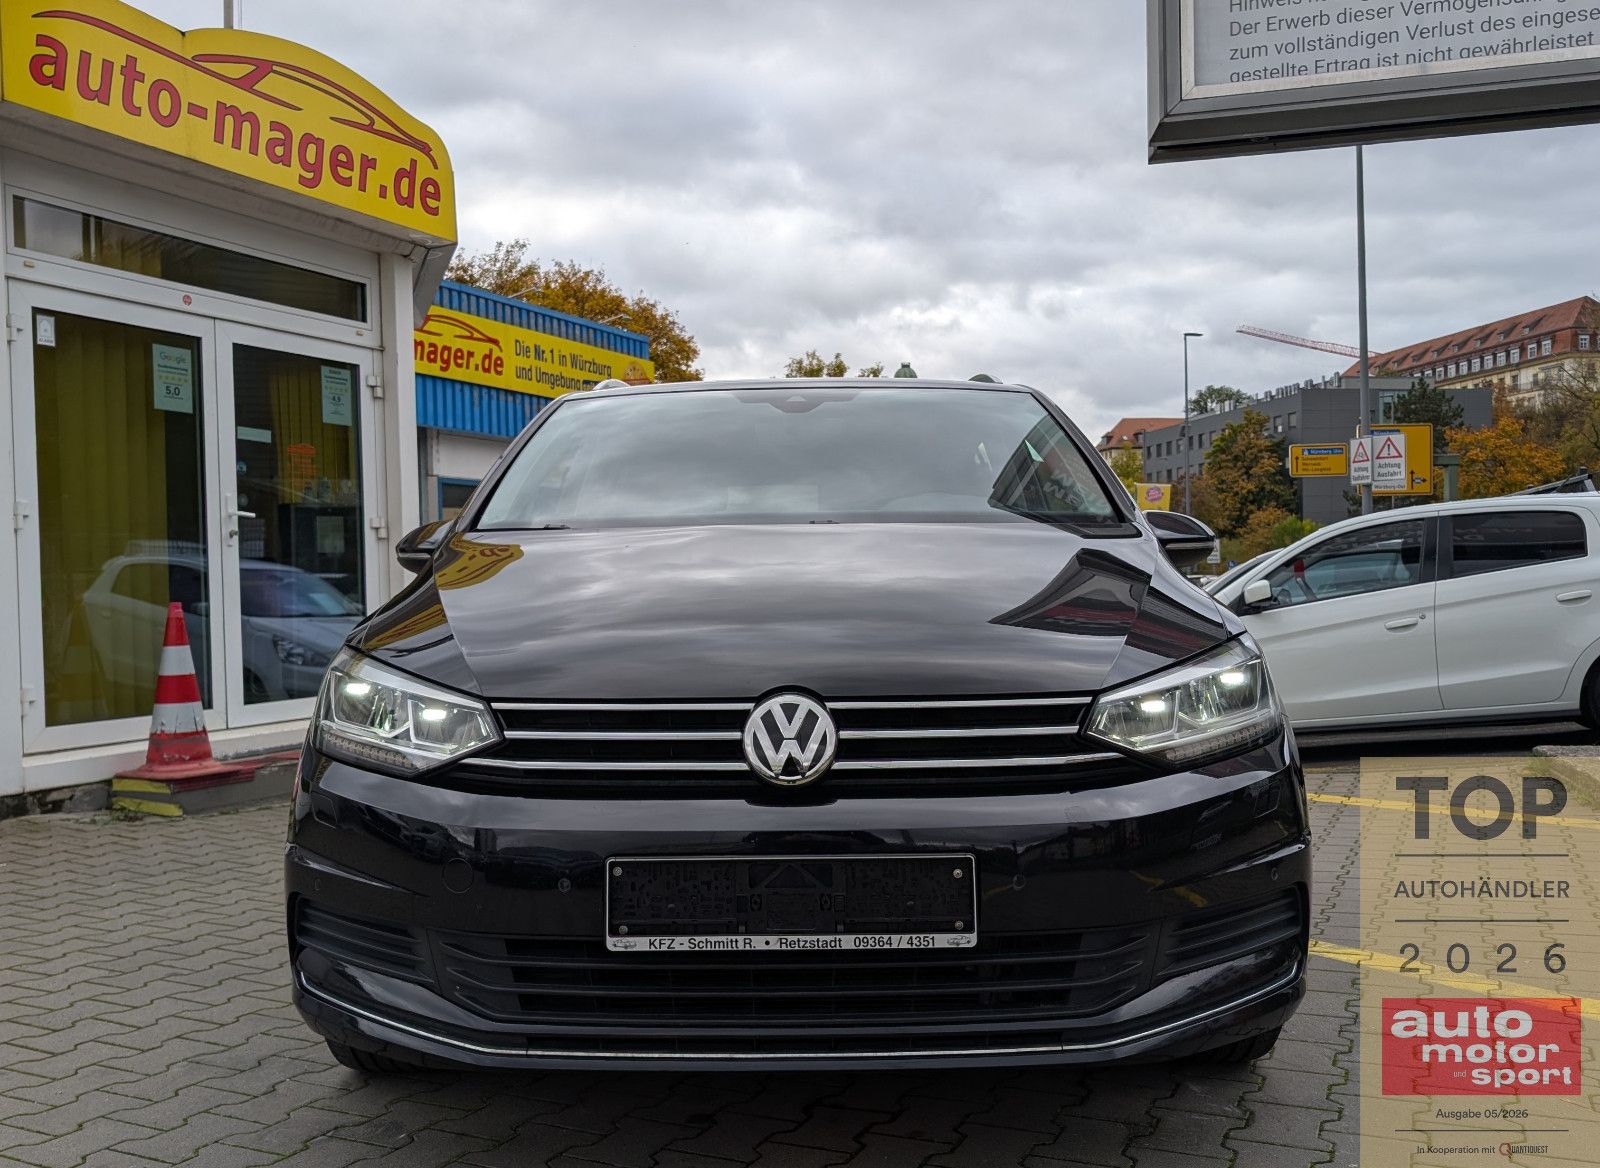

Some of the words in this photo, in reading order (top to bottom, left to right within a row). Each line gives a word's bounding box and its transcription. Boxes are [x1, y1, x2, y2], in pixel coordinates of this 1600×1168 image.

[1229, 21, 1261, 36] Der
[1266, 10, 1331, 32] Erwerb
[1336, 5, 1395, 25] dieser
[1229, 44, 1268, 61] zum
[1274, 29, 1400, 54] vollständigen
[1405, 19, 1475, 41] Verlust
[1480, 16, 1516, 33] des
[1229, 62, 1308, 83] gestellte
[1377, 52, 1400, 68] ist
[1405, 46, 1453, 65] nicht
[1459, 31, 1595, 59] gewährleistet
[29, 33, 441, 217] auto-mager.de
[514, 339, 531, 359] Die
[558, 350, 567, 367] in
[569, 352, 612, 379] Würzburg
[515, 365, 533, 381] und
[535, 367, 581, 390] Umgebung
[1378, 462, 1401, 470] Achtung
[649, 938, 676, 950] KFZ
[687, 938, 740, 950] Schmitt
[743, 938, 757, 950] R.
[778, 936, 843, 950] Retzstadt
[853, 936, 893, 949] 09364
[906, 935, 937, 948] 4351
